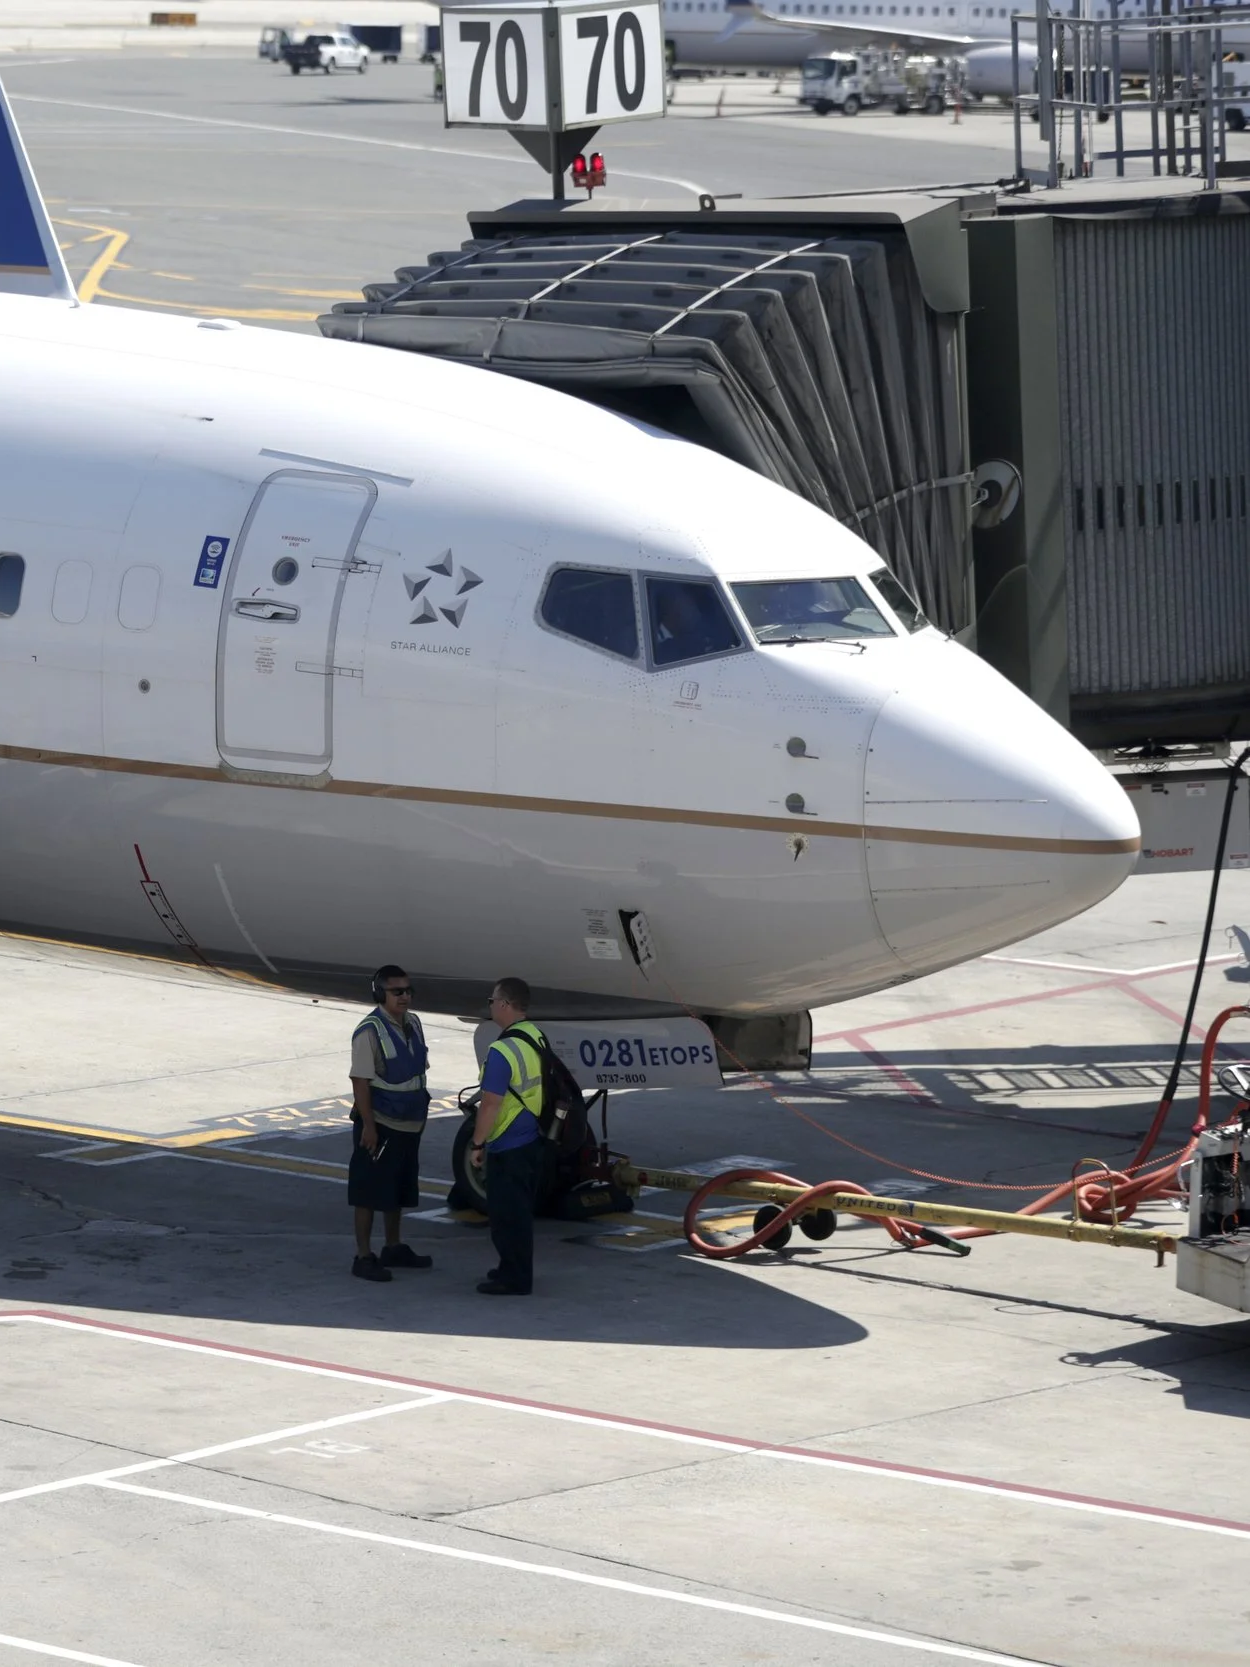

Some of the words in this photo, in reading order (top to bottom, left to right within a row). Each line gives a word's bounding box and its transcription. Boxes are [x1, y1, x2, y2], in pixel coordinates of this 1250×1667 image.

[459, 19, 528, 121] 70
[576, 11, 646, 112] 70
[390, 641, 417, 651] STAR
[419, 643, 471, 656] ALLIANCE
[1152, 847, 1194, 858] HOBART
[579, 1039, 647, 1067] 0281
[649, 1045, 713, 1065] ETOPS
[836, 1195, 897, 1212] UNITED
